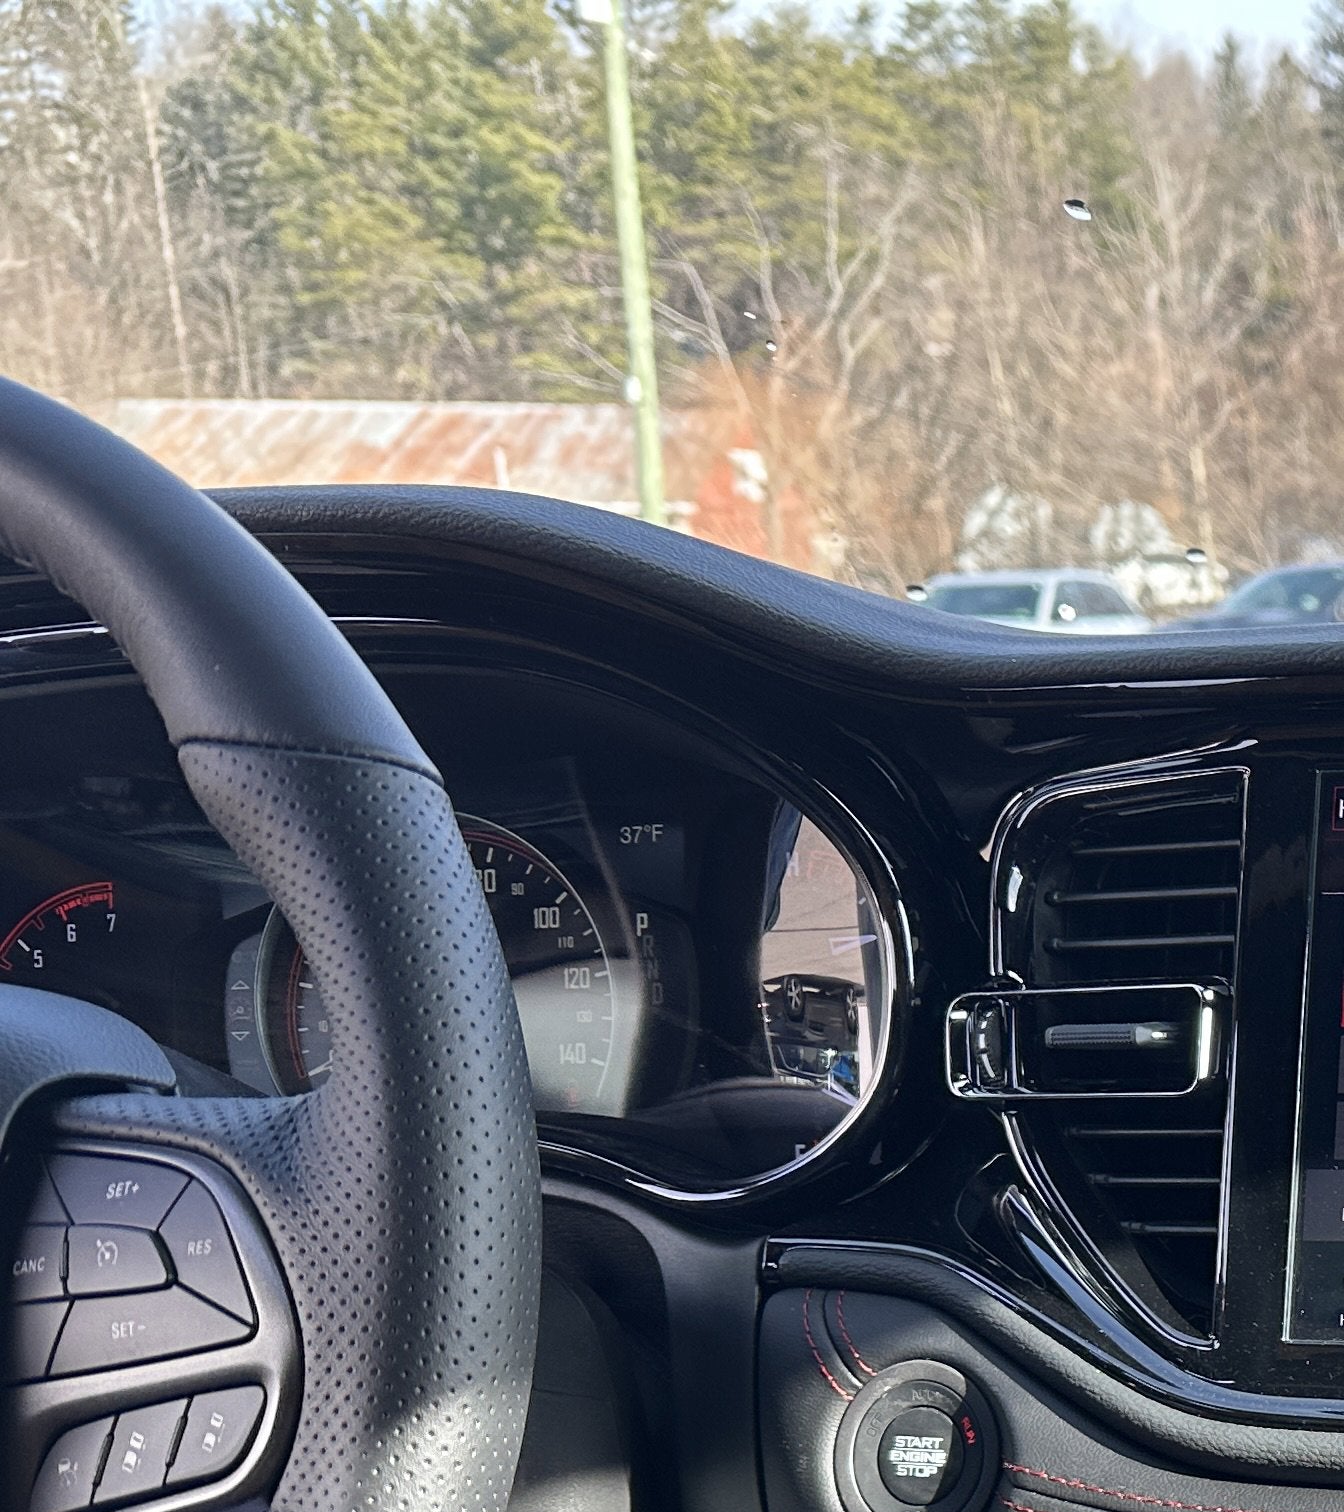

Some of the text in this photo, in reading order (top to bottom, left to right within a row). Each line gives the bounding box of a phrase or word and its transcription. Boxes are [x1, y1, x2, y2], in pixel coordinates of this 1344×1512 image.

[511, 883, 525, 895] 90
[106, 913, 116, 932] 7
[533, 907, 560, 929] 100
[636, 913, 648, 937] P
[66, 923, 77, 942] 6
[558, 936, 574, 949] 110
[33, 949, 43, 968] 5
[564, 967, 590, 989] 120
[559, 1043, 587, 1064] 140
[106, 1181, 139, 1199] SET+
[187, 1239, 212, 1255] RES
[12, 1257, 45, 1275] CANC
[895, 1435, 944, 1449] START
[890, 1450, 948, 1463] ENGINE
[896, 1465, 938, 1478] STOP
